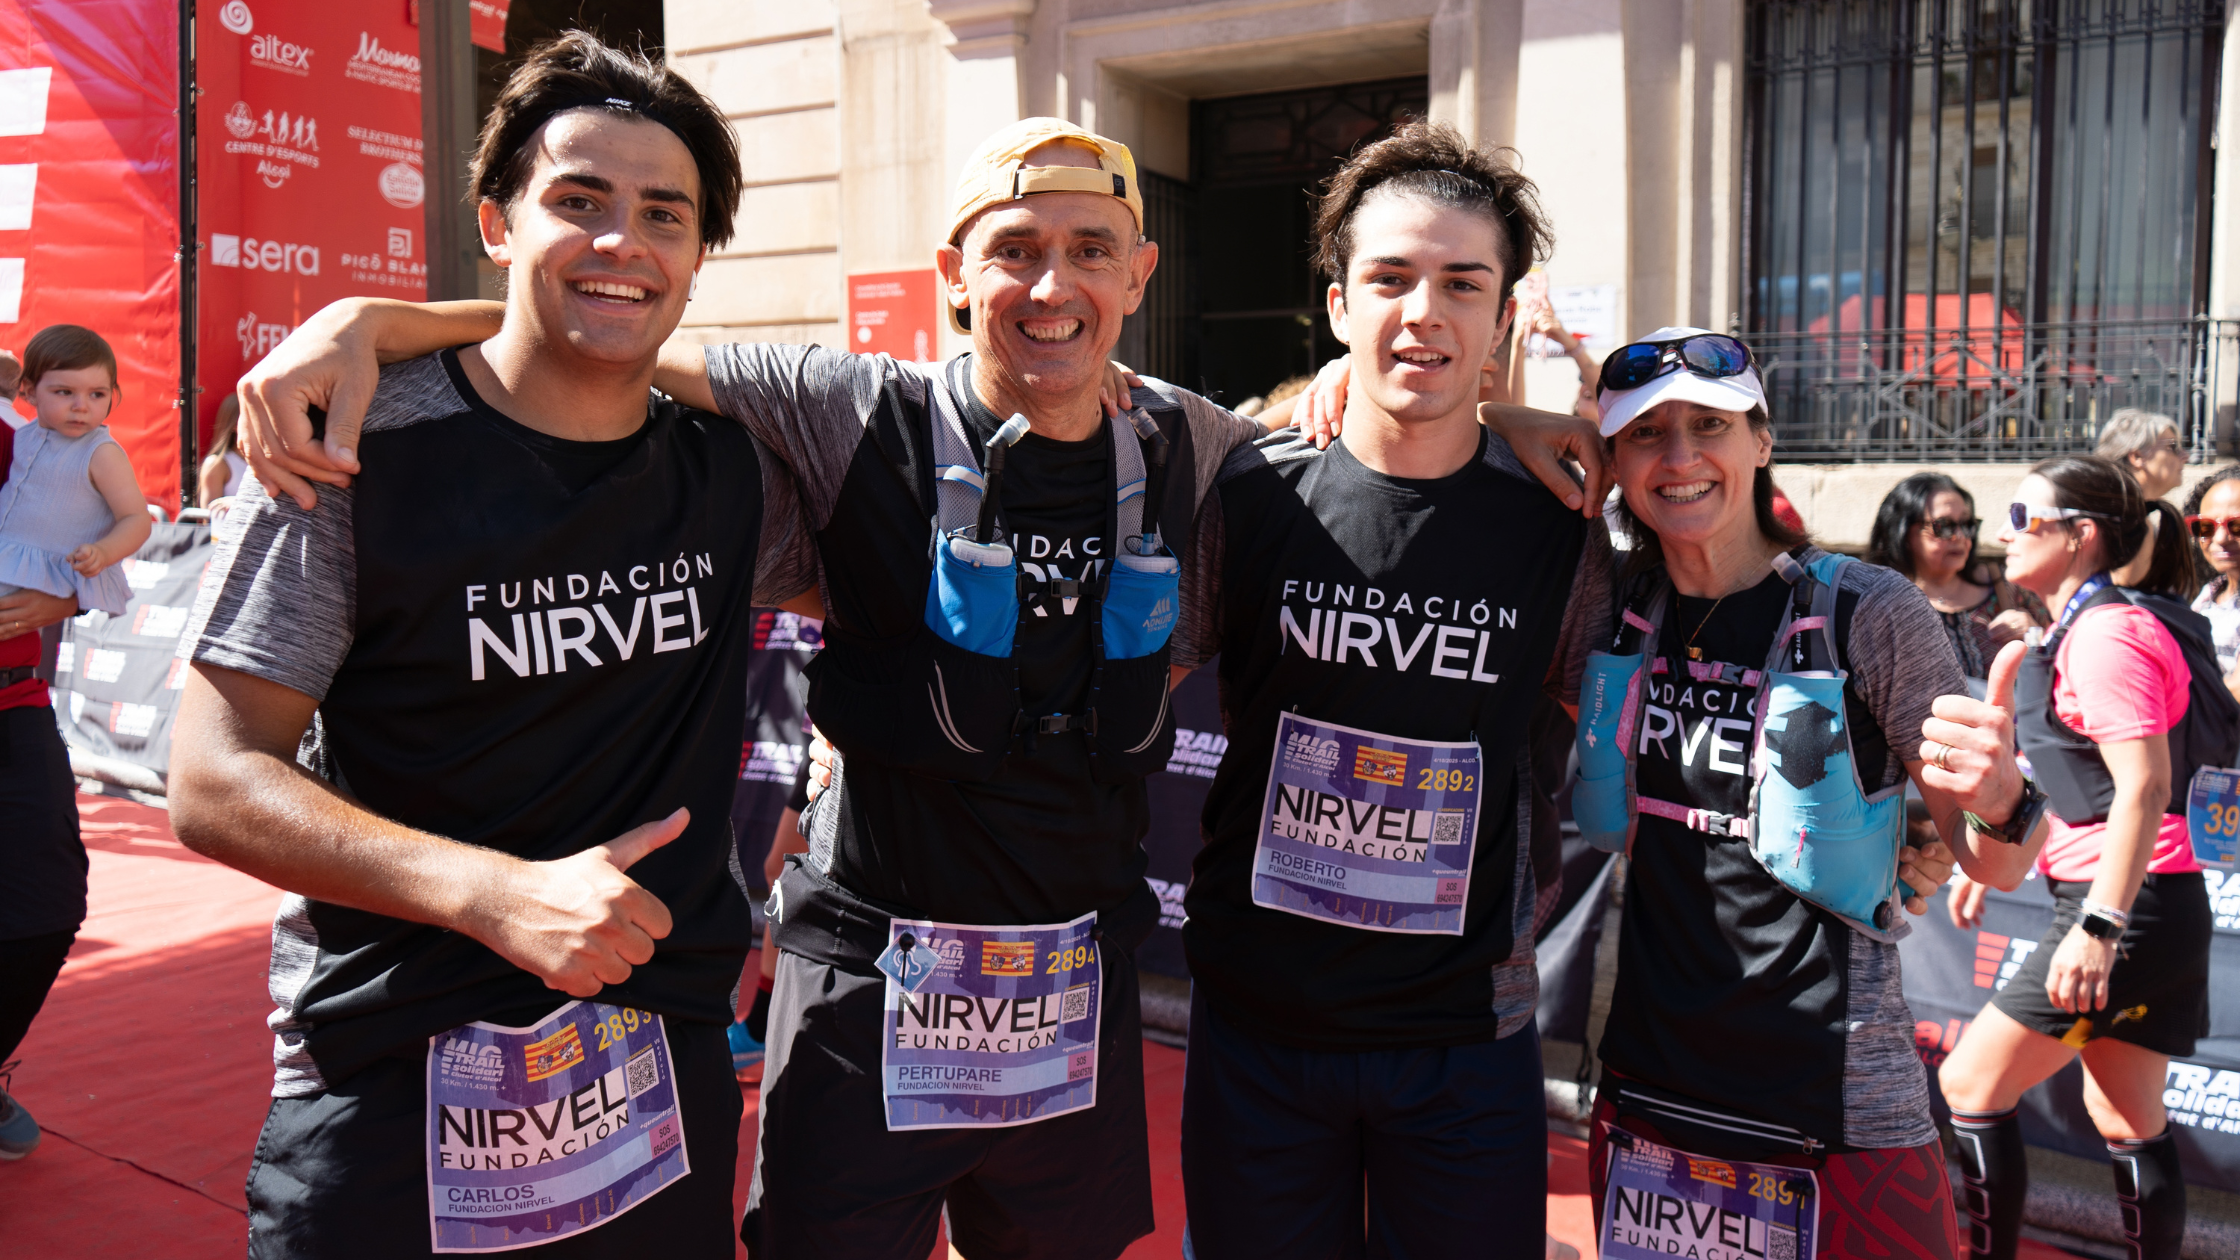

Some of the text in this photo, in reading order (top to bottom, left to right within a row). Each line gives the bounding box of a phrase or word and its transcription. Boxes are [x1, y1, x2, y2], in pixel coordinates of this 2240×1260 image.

[250, 34, 310, 71] aitex
[225, 141, 320, 169] CENTRE D'ESPORTS
[256, 159, 291, 179] Alcoi
[242, 237, 319, 276] sera
[466, 552, 713, 612] FUNDACIÓN
[1282, 579, 1517, 630] FUNDACIÓN
[468, 586, 710, 681] NIRVEL
[1279, 605, 1500, 684] NIRVEL
[752, 741, 803, 763] TRAIL
[1297, 743, 1340, 760] TRAIL
[1307, 768, 1323, 776] 1.430
[1416, 768, 1474, 792] 2892
[1273, 782, 1428, 844] NIRVEL
[1271, 820, 1427, 863] FUNDACIÓN
[1268, 864, 1347, 890] FUNDACION NIRVEL
[1270, 850, 1346, 880] ROBERTO
[1445, 882, 1457, 891] SOS
[1046, 946, 1095, 975] 2894
[897, 992, 1058, 1033] NIRVEL
[896, 1030, 1057, 1053] FUNDACIÓN
[455, 1052, 505, 1069] TRAIL
[1076, 1055, 1087, 1066] SOS
[468, 1082, 488, 1090] 1.430
[897, 1081, 985, 1091] FUNDACION NIRVEL
[898, 1066, 1002, 1083] PERTUPARE
[439, 1074, 627, 1148] NIRVEL
[440, 1109, 630, 1170] FUNDACIÓN
[659, 1124, 671, 1138] SOS
[447, 1185, 535, 1203] CARLOS
[449, 1196, 555, 1213] FUNDACION NIRVEL
[1614, 1185, 1764, 1258] NIRVEL
